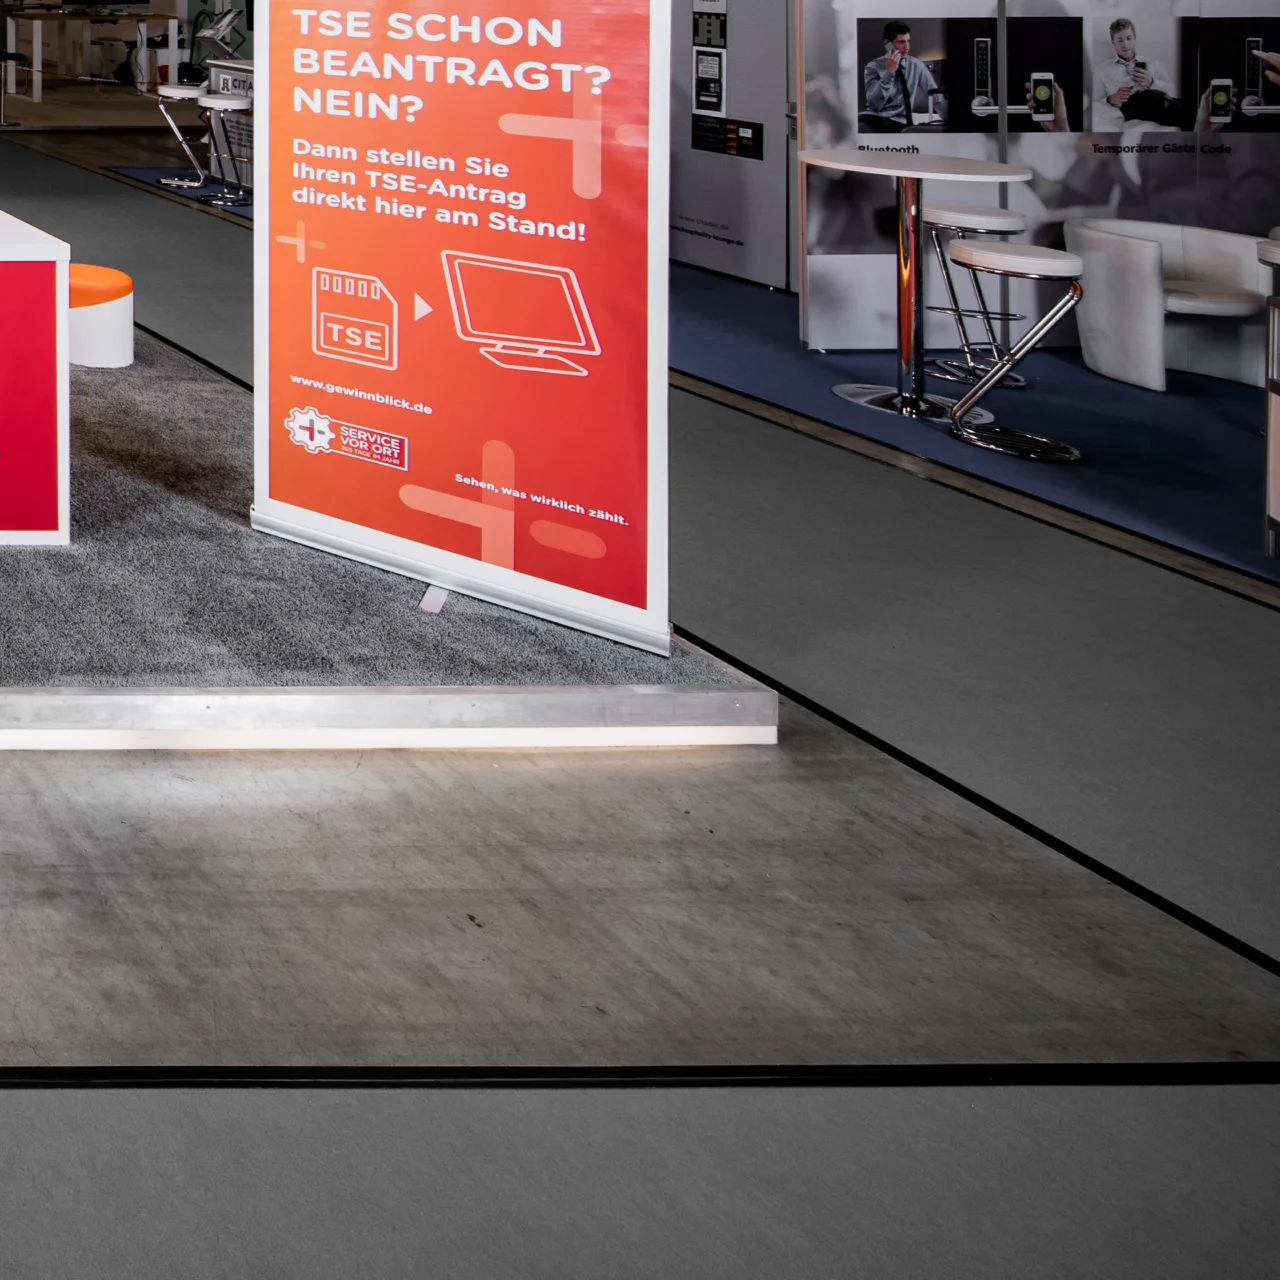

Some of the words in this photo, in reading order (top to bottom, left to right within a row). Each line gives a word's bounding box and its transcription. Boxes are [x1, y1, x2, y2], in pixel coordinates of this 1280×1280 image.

[292, 9, 371, 38] TSE
[387, 13, 562, 48] SCHON
[232, 78, 254, 91] CITA
[293, 47, 611, 95] BEANTRAGT?
[293, 86, 424, 122] NEIN?
[293, 138, 357, 161] Dann
[366, 146, 456, 172] stellen
[465, 155, 510, 178] Sie
[1092, 143, 1160, 155] Temporärer
[1162, 143, 1196, 155] Gäste
[1200, 144, 1232, 155] Code
[293, 162, 356, 185] Ihren
[365, 170, 527, 210] TSE-Antrag
[292, 186, 367, 212] direkt
[375, 196, 427, 220] hier
[435, 208, 479, 227] am
[488, 211, 587, 242] Stand!
[326, 323, 383, 352] TSE
[290, 374, 433, 415] www.gewinnblick.de
[340, 426, 401, 450] SERVICE
[340, 436, 369, 451] VOR
[372, 444, 401, 458] ORT
[455, 473, 499, 495] Sehen,
[501, 486, 528, 500] was
[530, 491, 586, 515] wirklich
[588, 507, 630, 527] zählt.
